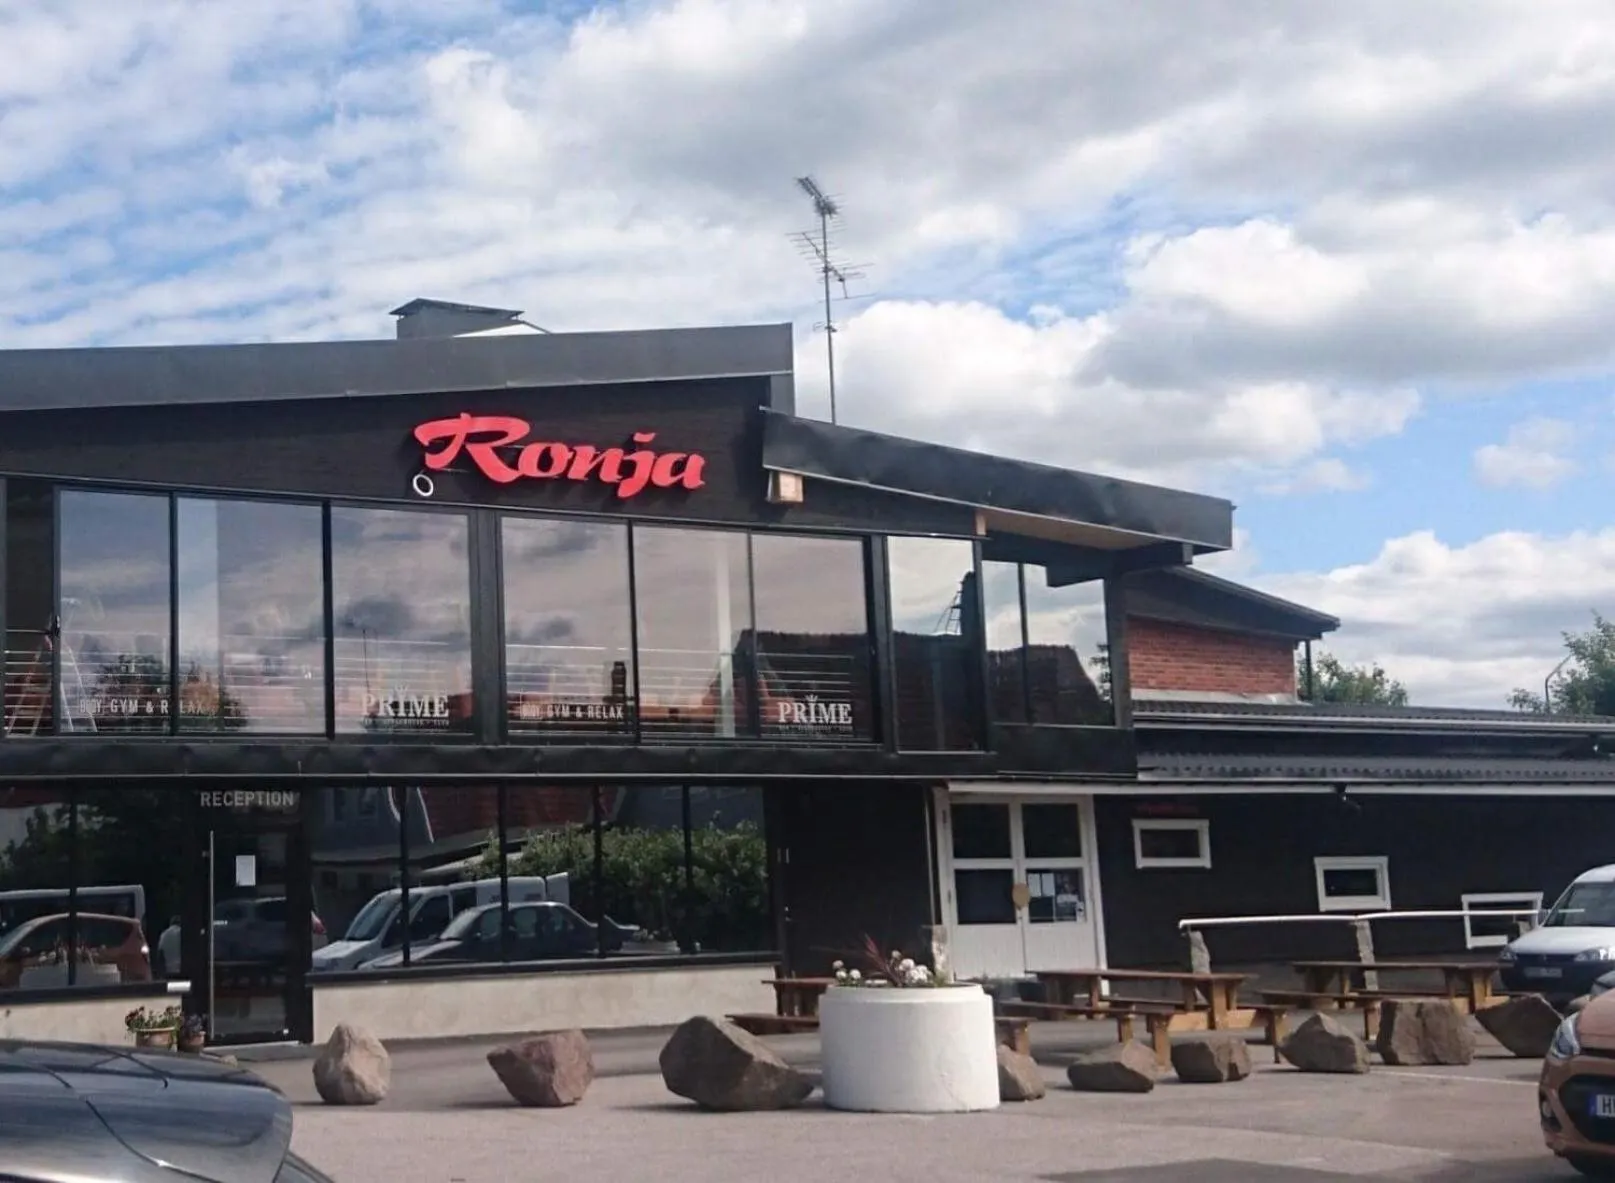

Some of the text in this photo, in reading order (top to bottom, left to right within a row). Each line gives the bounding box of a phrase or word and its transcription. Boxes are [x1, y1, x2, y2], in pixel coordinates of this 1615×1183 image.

[414, 412, 705, 498] Ronja
[110, 699, 138, 713] GYM
[145, 700, 154, 713] &
[160, 700, 204, 714] RLAX
[360, 693, 449, 717] PRIME
[546, 704, 570, 717] GYM
[575, 705, 583, 718] &
[588, 705, 624, 719] RELAX
[777, 702, 853, 724] PRIME
[200, 790, 294, 807] RECEPTION
[1602, 1095, 1615, 1115] H
